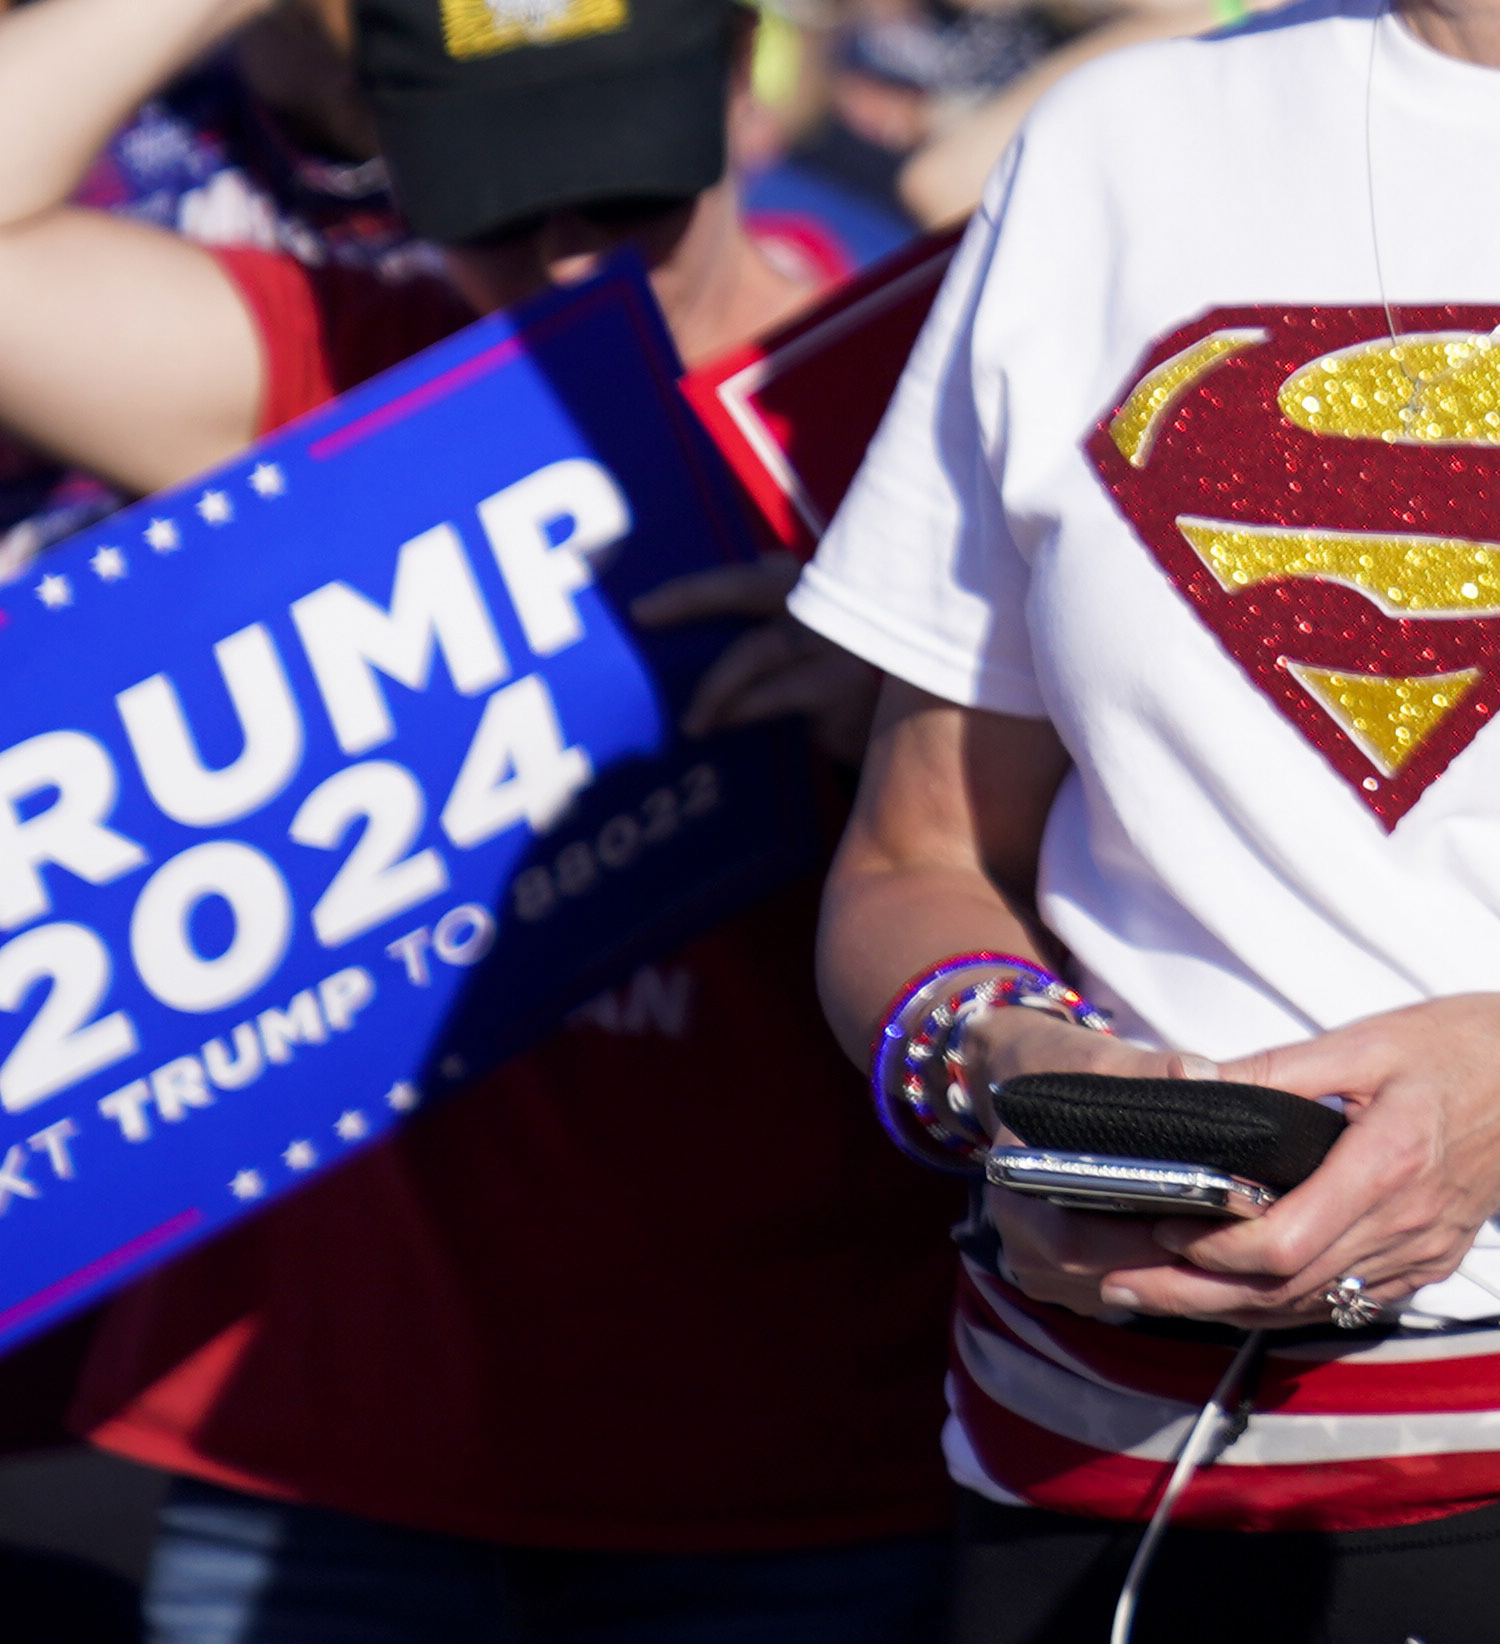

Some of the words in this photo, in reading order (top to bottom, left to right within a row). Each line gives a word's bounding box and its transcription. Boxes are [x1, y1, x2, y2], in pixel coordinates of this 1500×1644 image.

[0, 674, 593, 1113] 2024
[97, 965, 378, 1145] TRUMP
[387, 901, 496, 989] TO
